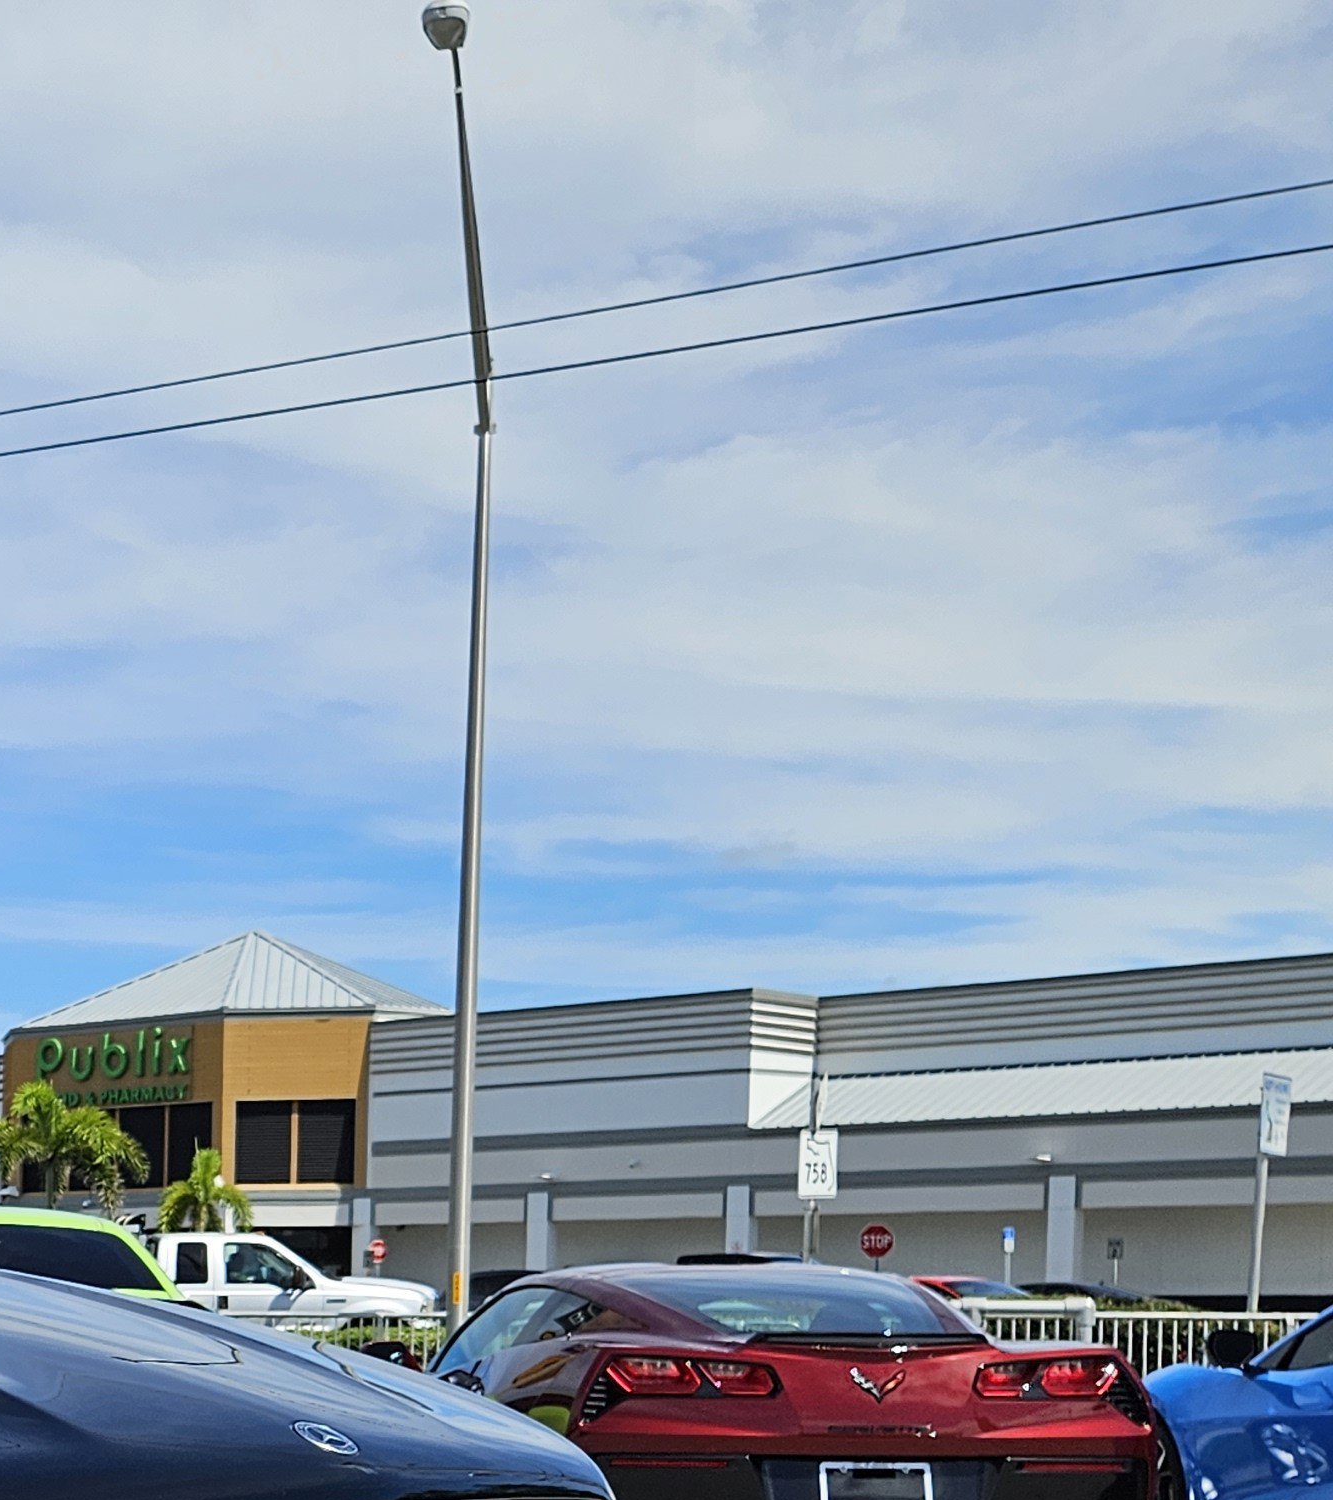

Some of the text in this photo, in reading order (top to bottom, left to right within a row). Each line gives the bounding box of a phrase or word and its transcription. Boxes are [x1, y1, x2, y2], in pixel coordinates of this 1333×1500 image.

[36, 1026, 191, 1082] Publix
[100, 1084, 188, 1105] PHARMACY
[805, 1163, 828, 1184] 758
[861, 1234, 893, 1249] STOP
